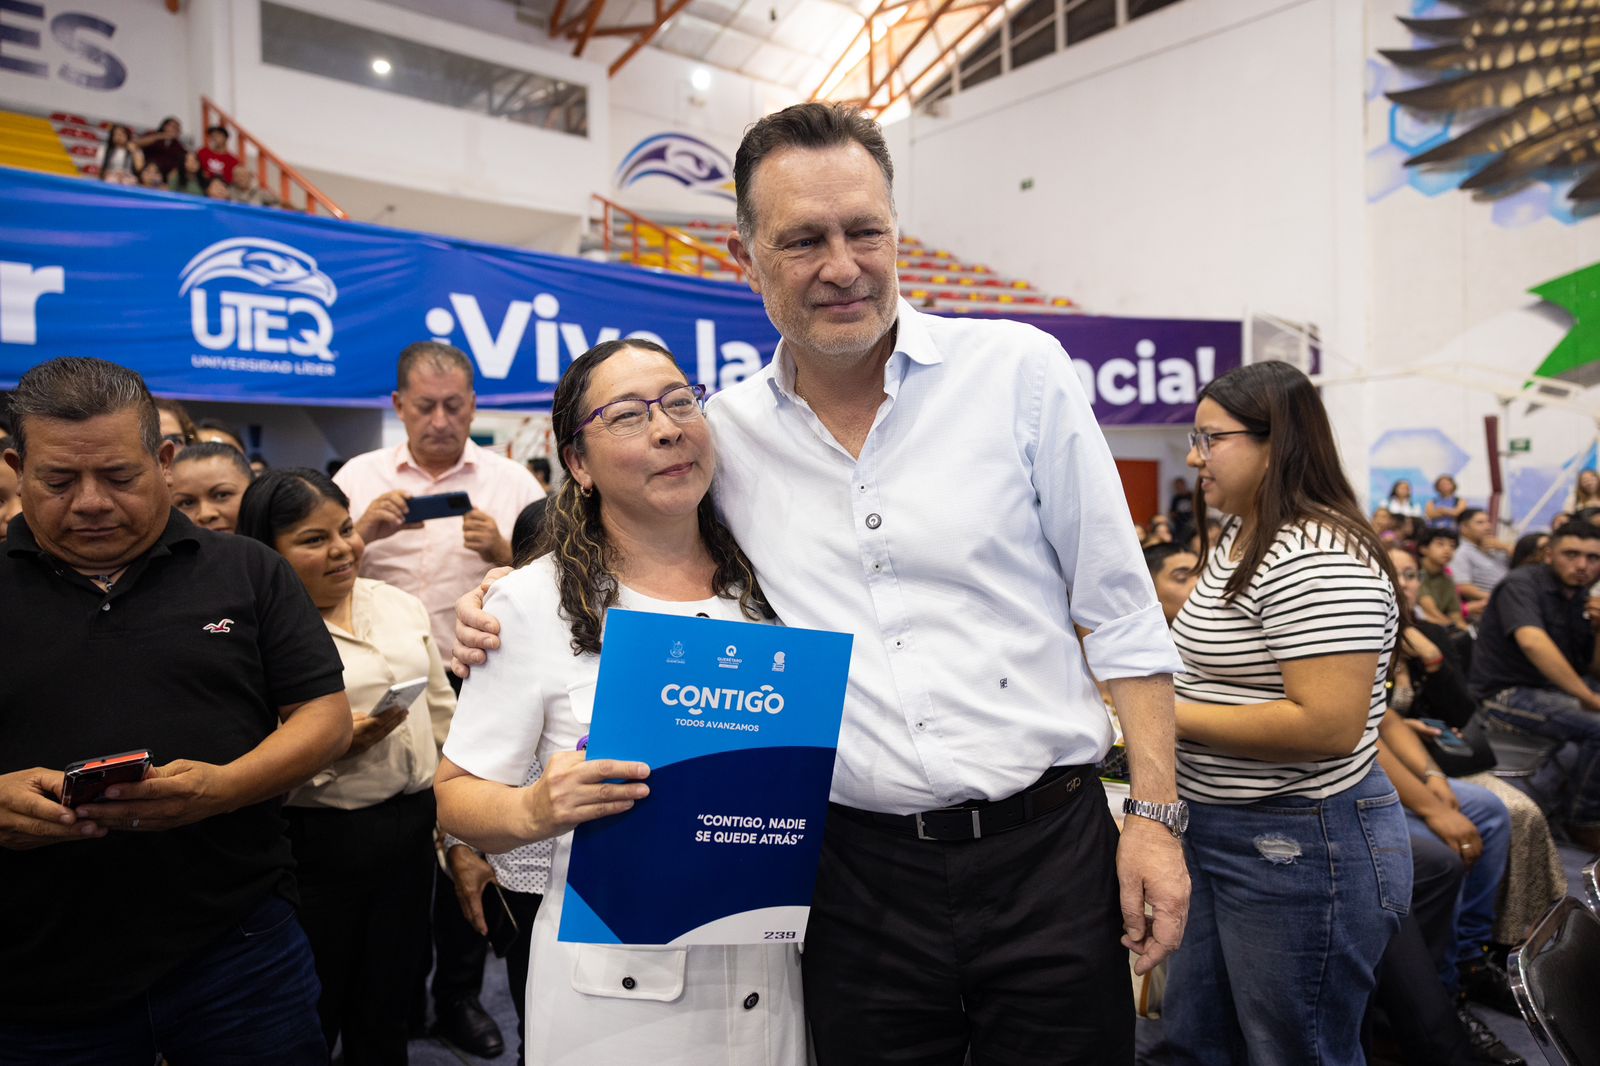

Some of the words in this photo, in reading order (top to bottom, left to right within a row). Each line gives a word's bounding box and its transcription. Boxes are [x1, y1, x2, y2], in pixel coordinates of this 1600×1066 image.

[191, 288, 336, 362] UTEQ
[191, 354, 293, 374] UNIVERSIDAD
[661, 683, 785, 715] CONTIGO
[675, 718, 705, 728] TODOS
[706, 721, 760, 732] AVANZAMOS
[697, 814, 766, 830] “CONTIGO,
[768, 818, 807, 830] NADIE
[695, 830, 712, 842] SE
[713, 831, 758, 844] QUEDE
[759, 831, 804, 846] ATRÁS”
[764, 931, 797, 940] 239
